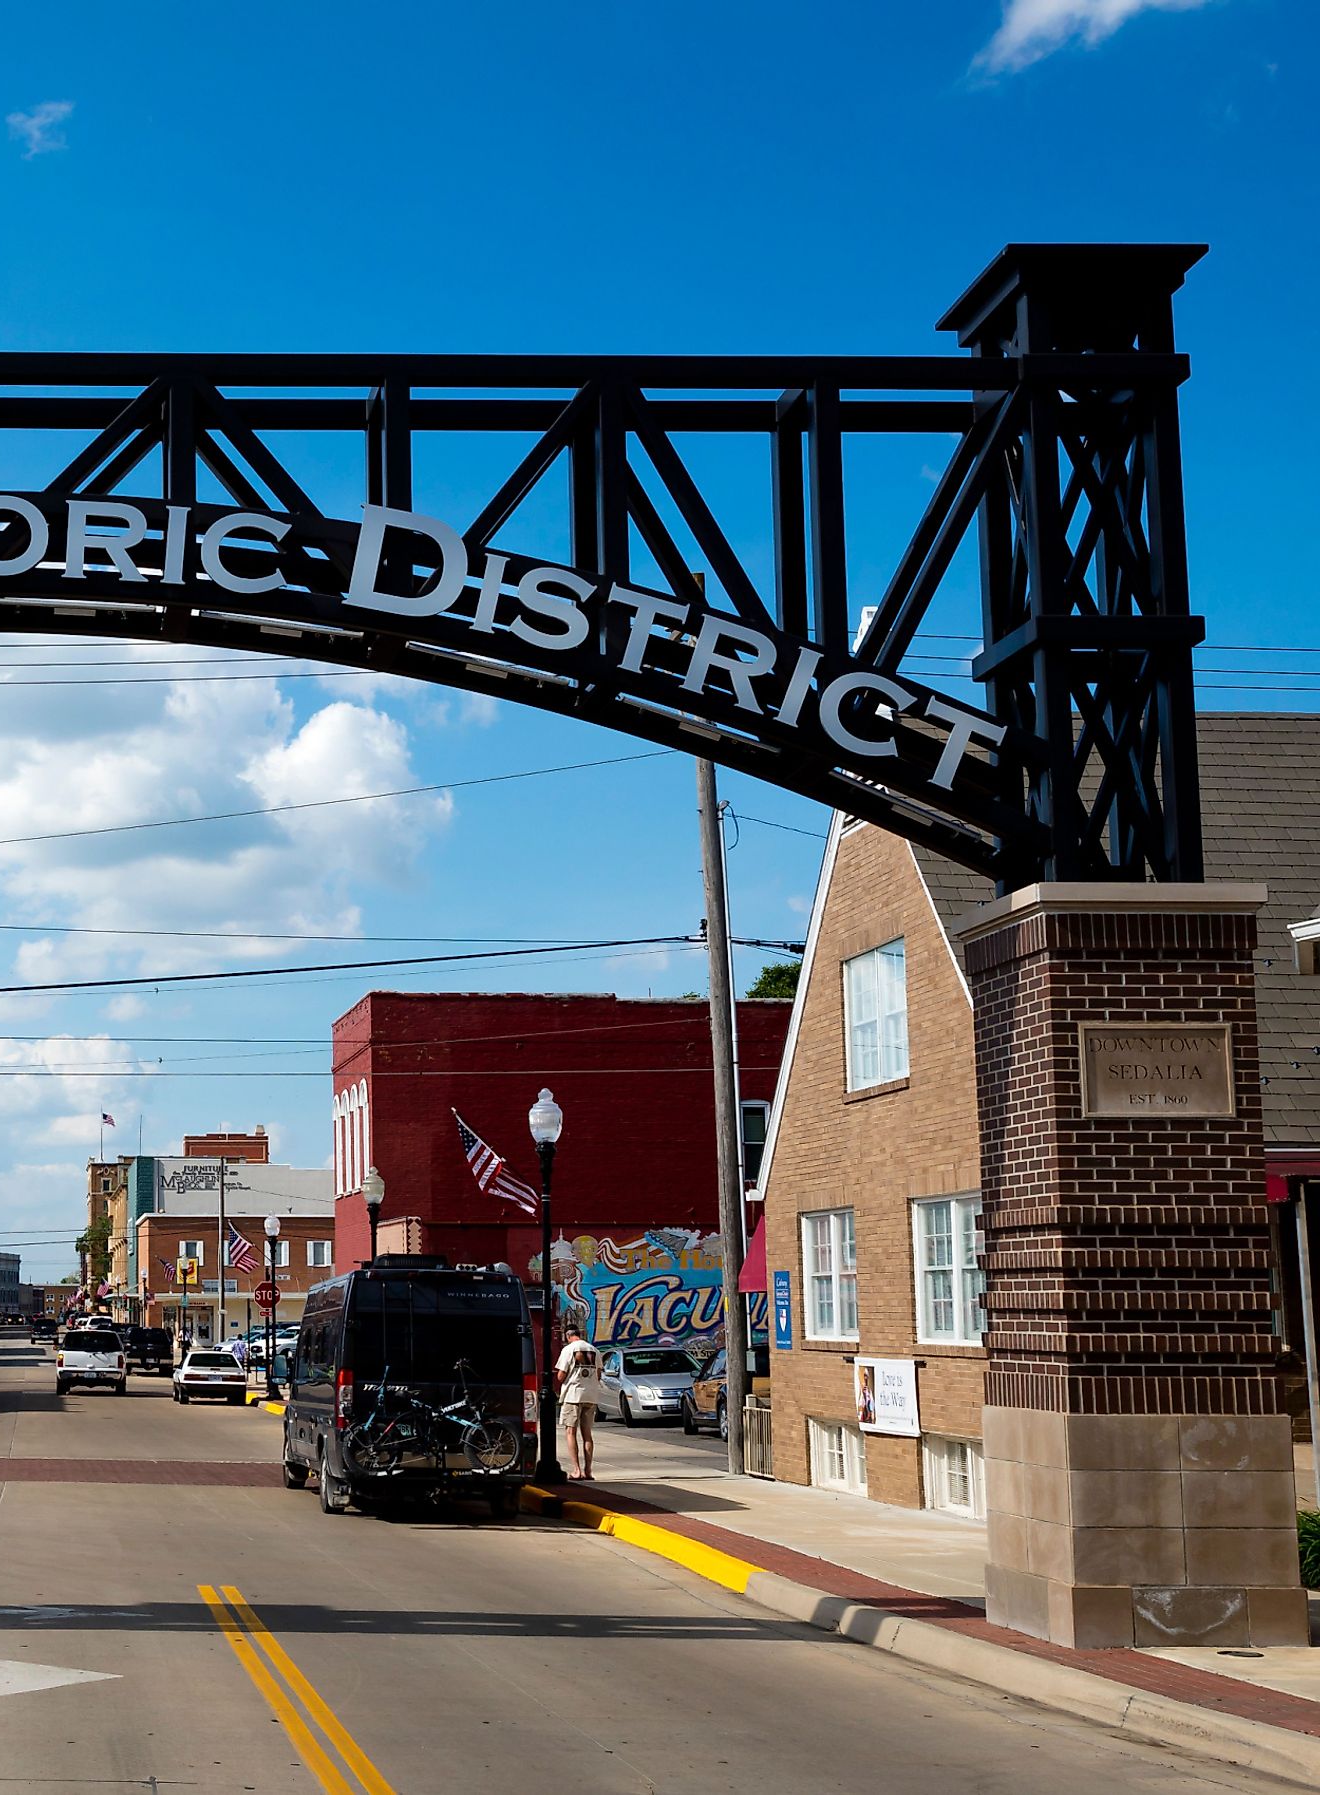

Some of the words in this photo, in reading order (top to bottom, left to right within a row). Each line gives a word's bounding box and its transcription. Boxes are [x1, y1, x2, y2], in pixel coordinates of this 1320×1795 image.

[342, 503, 1008, 791] DISTRICT
[1089, 1037, 1221, 1053] DOWNTOWN
[1108, 1064, 1203, 1080] SEDALIA
[1129, 1093, 1159, 1105] EST.
[1164, 1095, 1188, 1105] 1860
[620, 1248, 671, 1270] The
[255, 1290, 280, 1300] STOP
[592, 1277, 768, 1343] VACU
